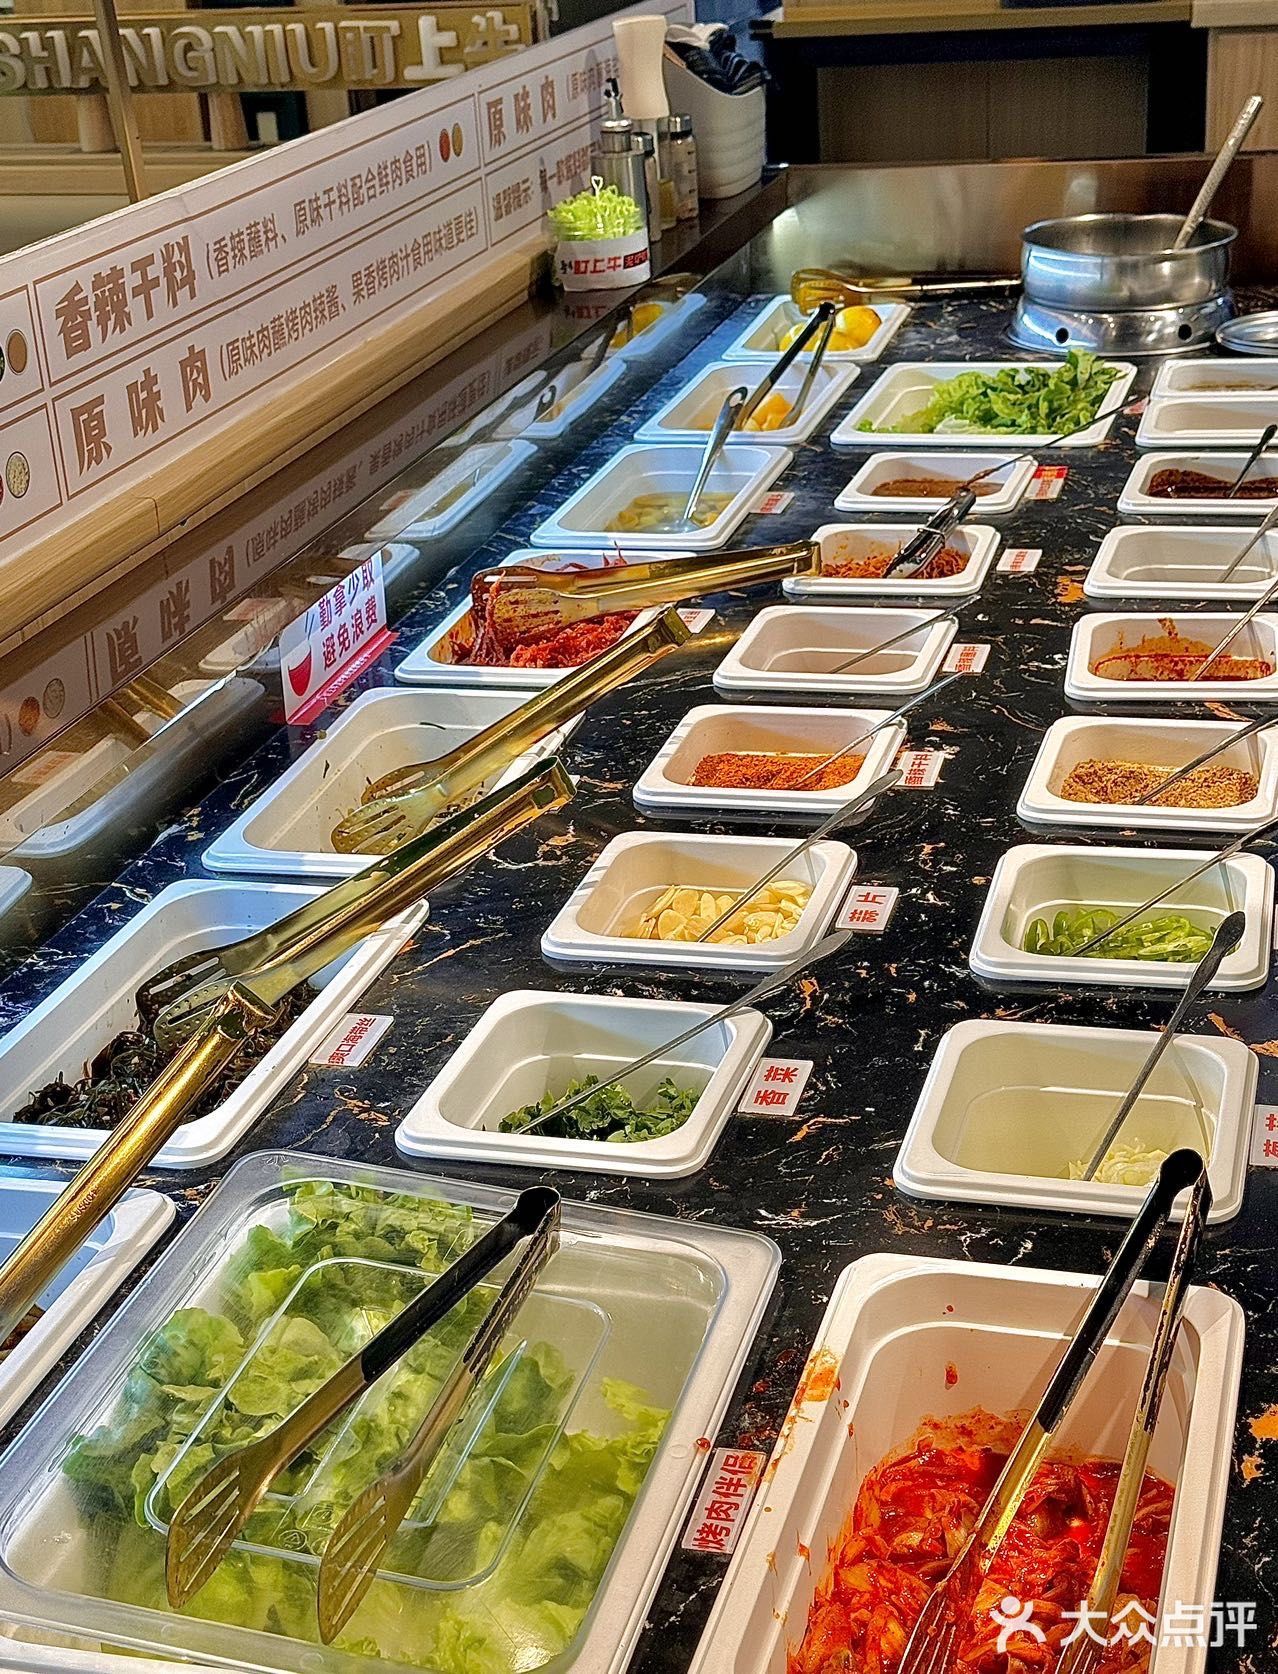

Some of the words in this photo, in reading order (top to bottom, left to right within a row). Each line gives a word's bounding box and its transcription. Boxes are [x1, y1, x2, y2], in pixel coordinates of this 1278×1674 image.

[55, 235, 197, 360] 香辣干料
[70, 344, 215, 477] 原味肉
[318, 558, 375, 632] 勤拿少取
[322, 594, 378, 671] 避免浪费
[848, 892, 887, 923] 蒜片
[327, 1017, 376, 1064] 爽口海带丝
[753, 1065, 799, 1106] 香菜
[691, 1453, 757, 1551] 烤肉伴侣
